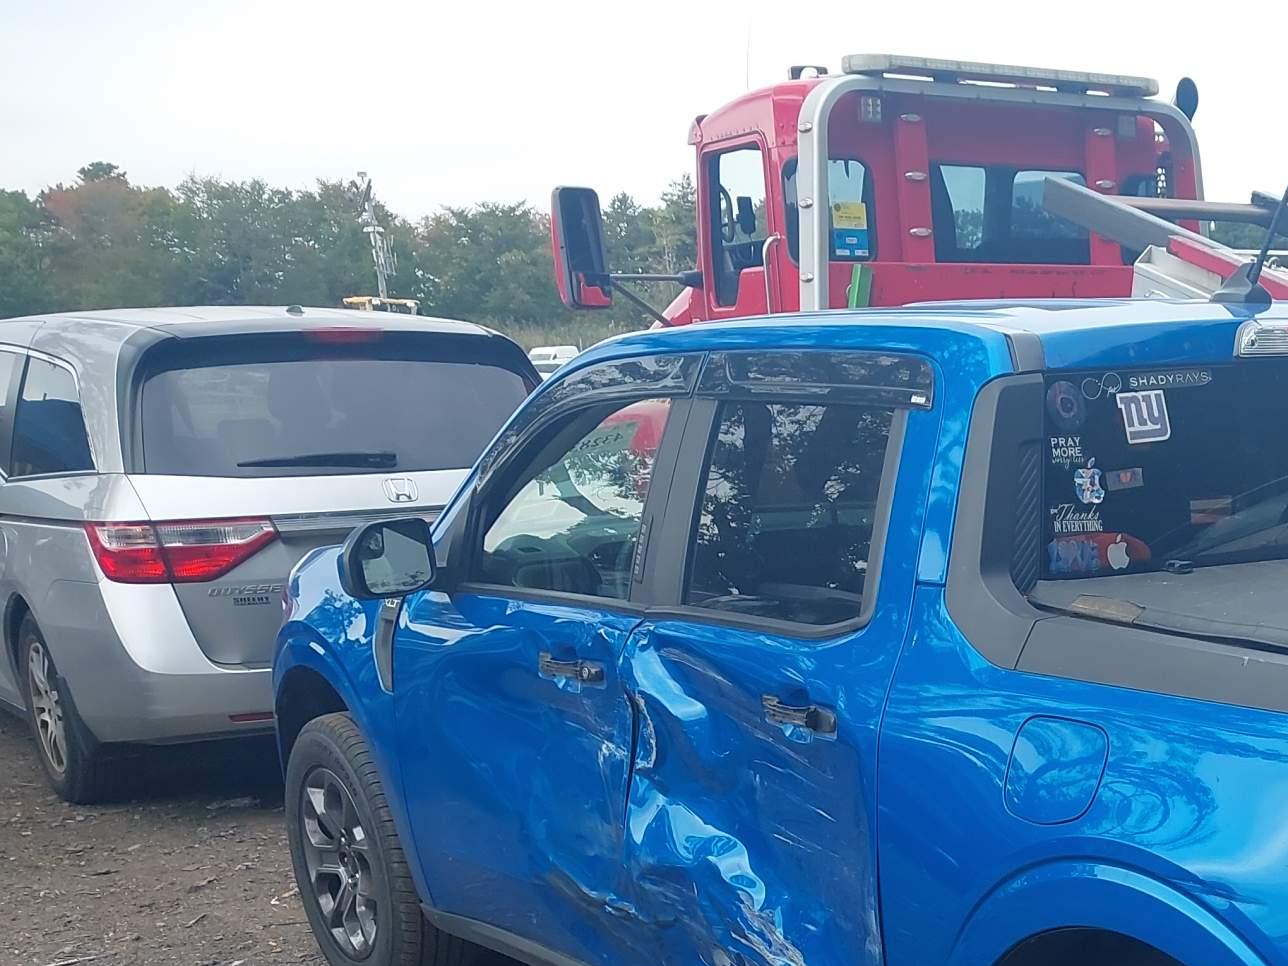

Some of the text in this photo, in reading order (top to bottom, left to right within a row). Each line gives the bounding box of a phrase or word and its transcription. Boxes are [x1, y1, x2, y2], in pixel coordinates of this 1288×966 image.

[1050, 436, 1081, 448] PRAY
[1052, 447, 1083, 458] MORE
[1056, 504, 1100, 521] Thanks
[1054, 520, 1103, 532] IN EVERYTHING
